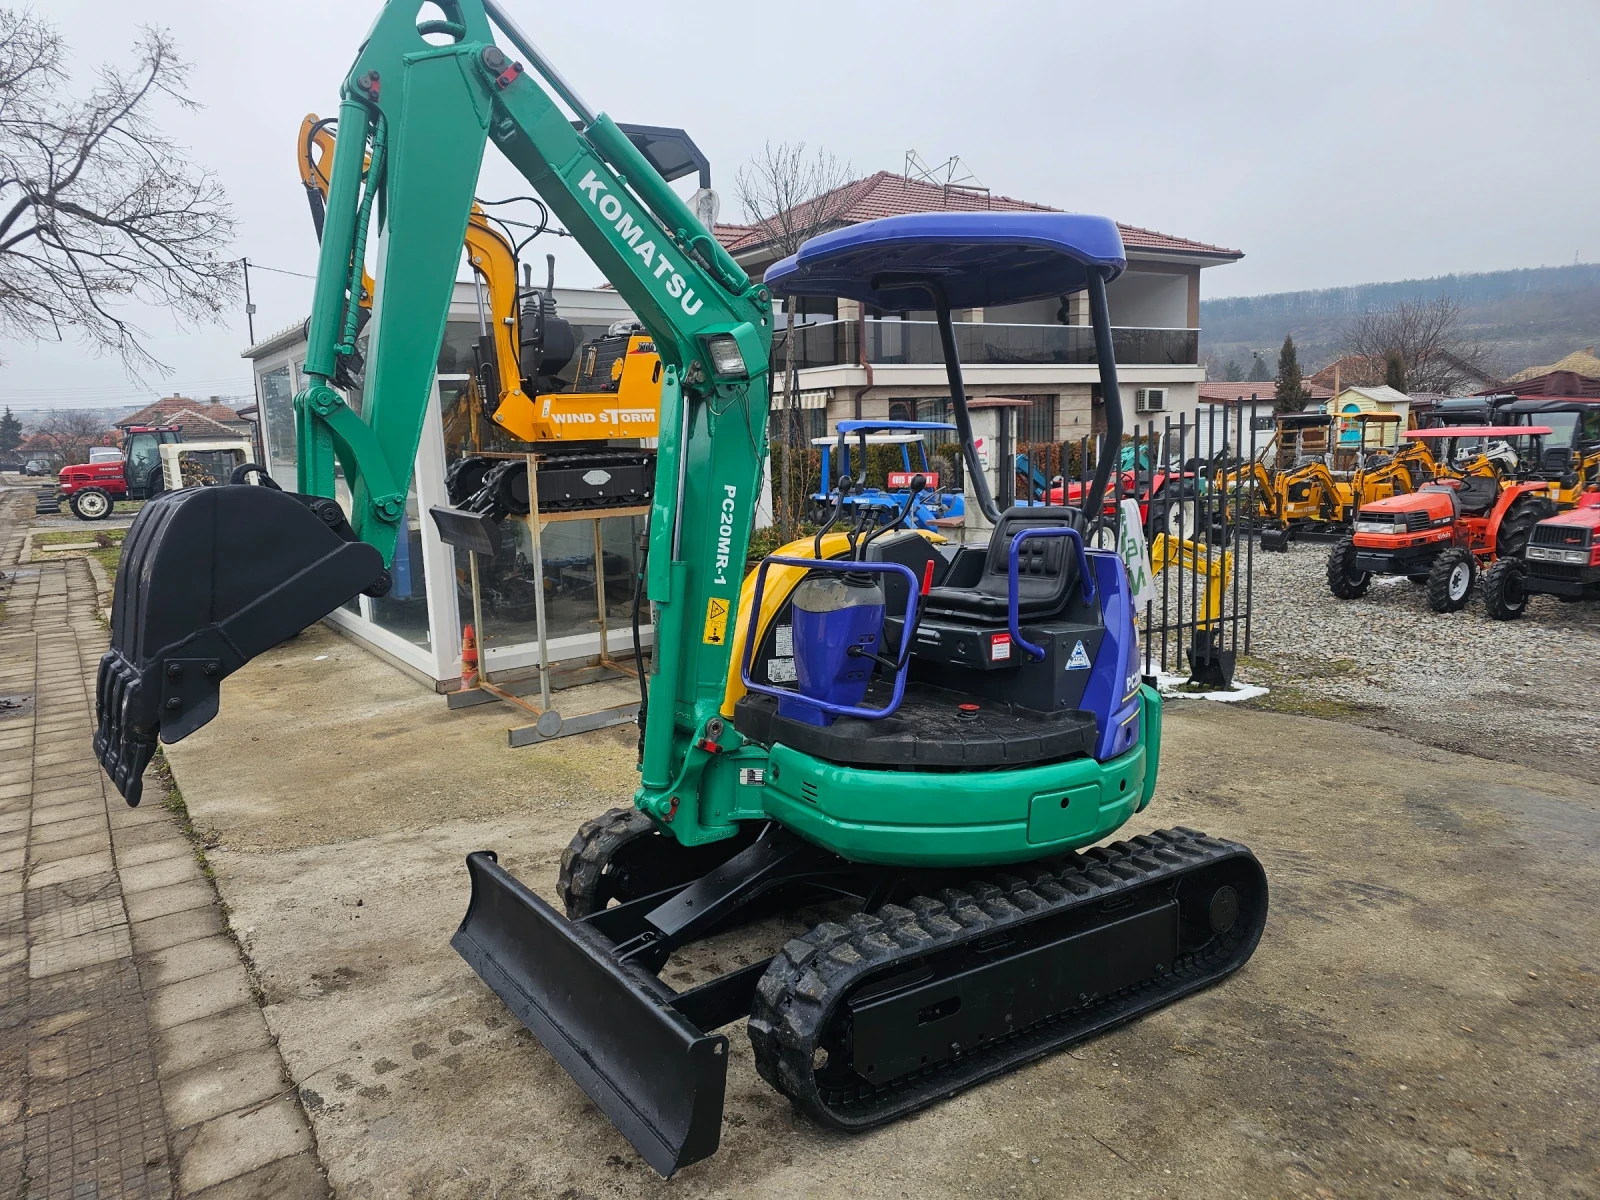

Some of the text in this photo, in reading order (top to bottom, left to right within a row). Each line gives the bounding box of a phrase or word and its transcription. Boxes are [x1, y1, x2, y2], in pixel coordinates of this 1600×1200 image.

[578, 169, 704, 316] KOMATSU
[550, 408, 656, 425] WIND STORM
[714, 484, 737, 585] PC20MR-1
